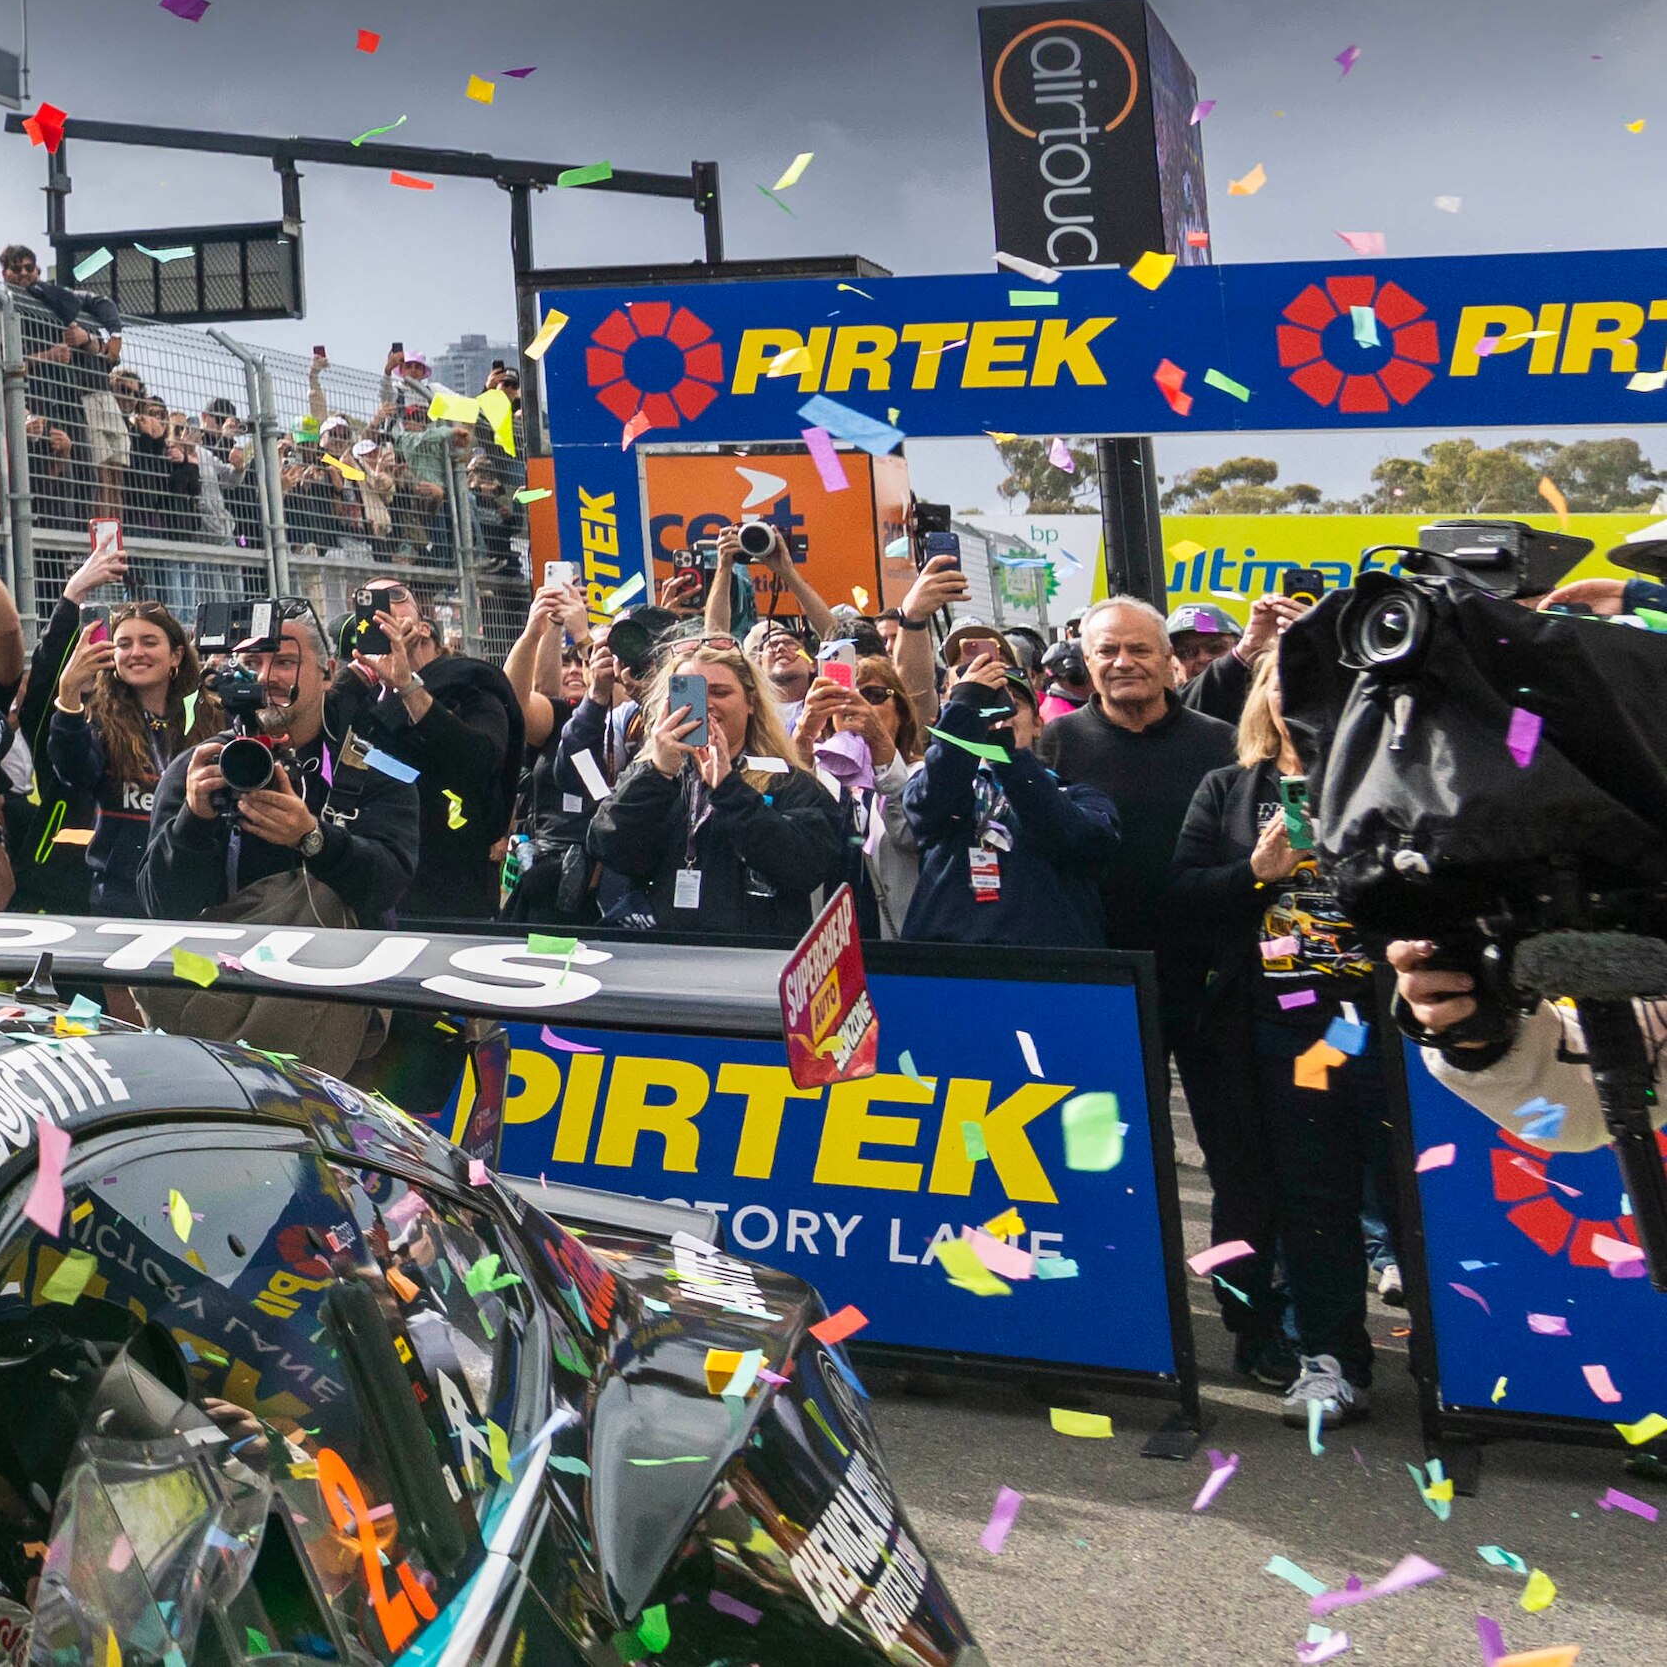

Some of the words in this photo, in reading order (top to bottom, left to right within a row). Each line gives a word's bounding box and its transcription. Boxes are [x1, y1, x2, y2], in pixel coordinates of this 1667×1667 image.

[732, 316, 1118, 395] PIRTEK
[578, 485, 621, 626] IRTEK
[1031, 524, 1059, 544] bp
[785, 892, 853, 1027] SUPERCHEAP
[450, 1048, 1075, 1205] PIRTEK
